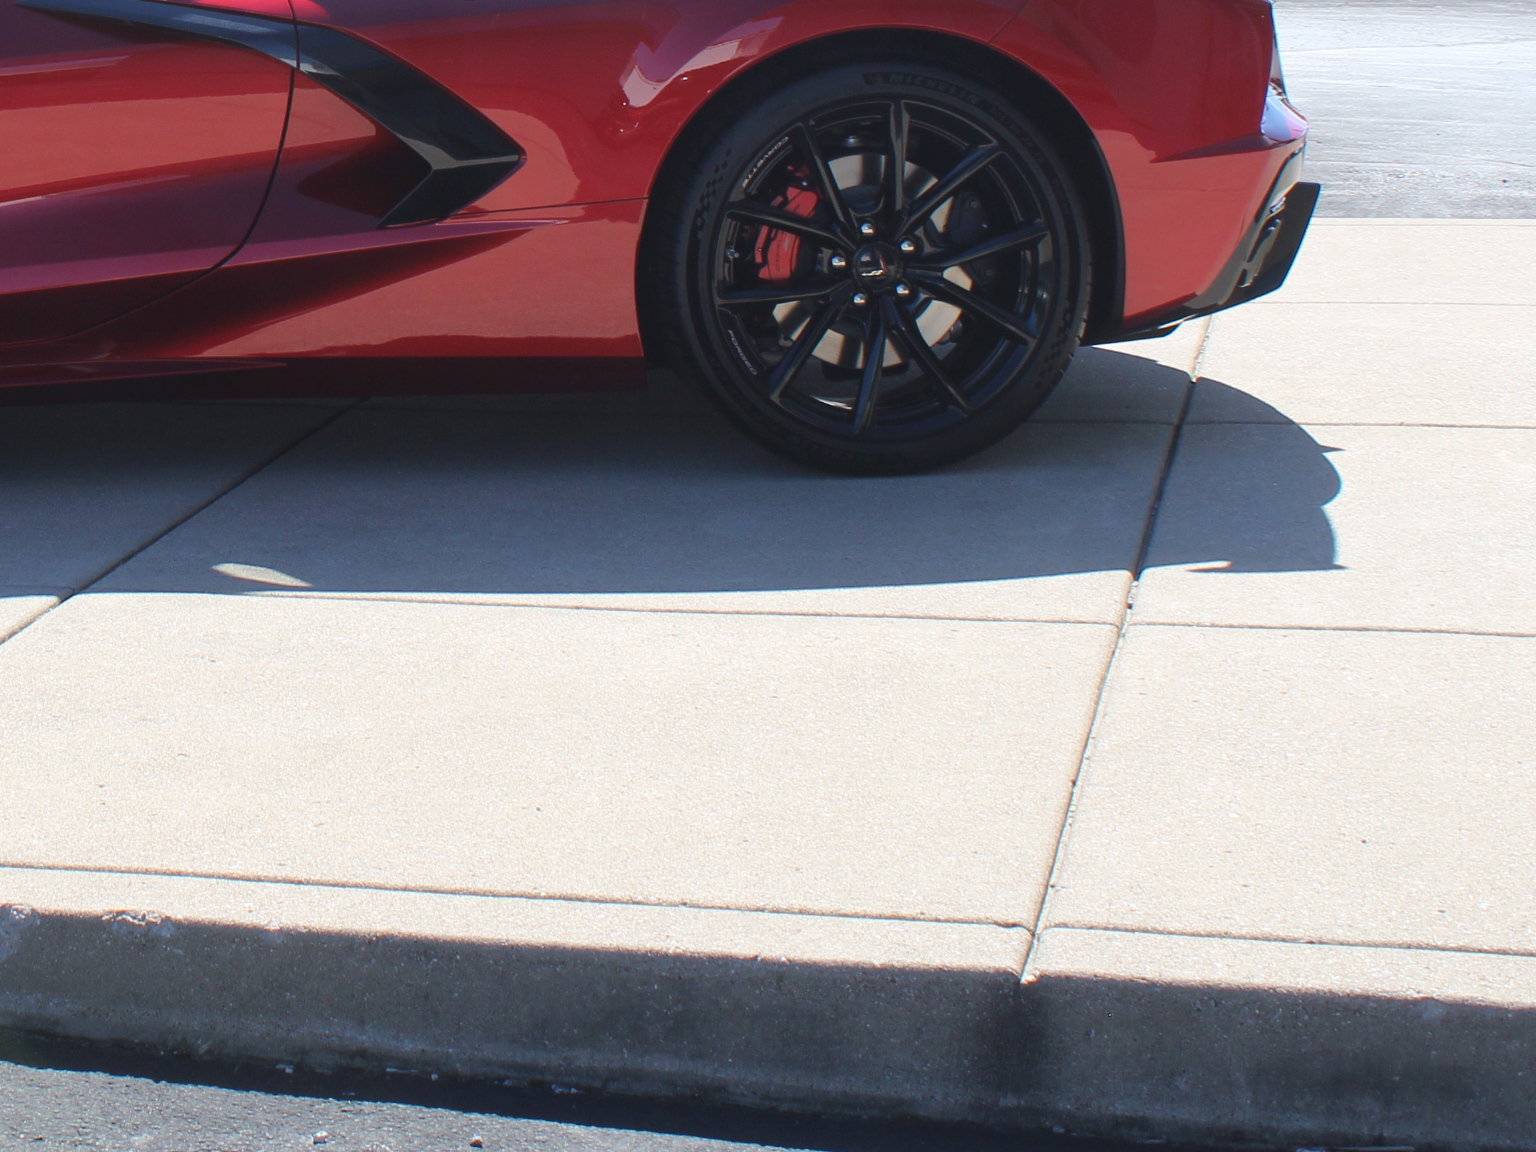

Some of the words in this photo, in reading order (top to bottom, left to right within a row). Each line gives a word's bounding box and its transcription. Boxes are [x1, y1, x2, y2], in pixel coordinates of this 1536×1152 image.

[888, 74, 980, 105] MICHELIN
[742, 136, 789, 188] CORVETTE
[727, 329, 758, 376] FORGED
